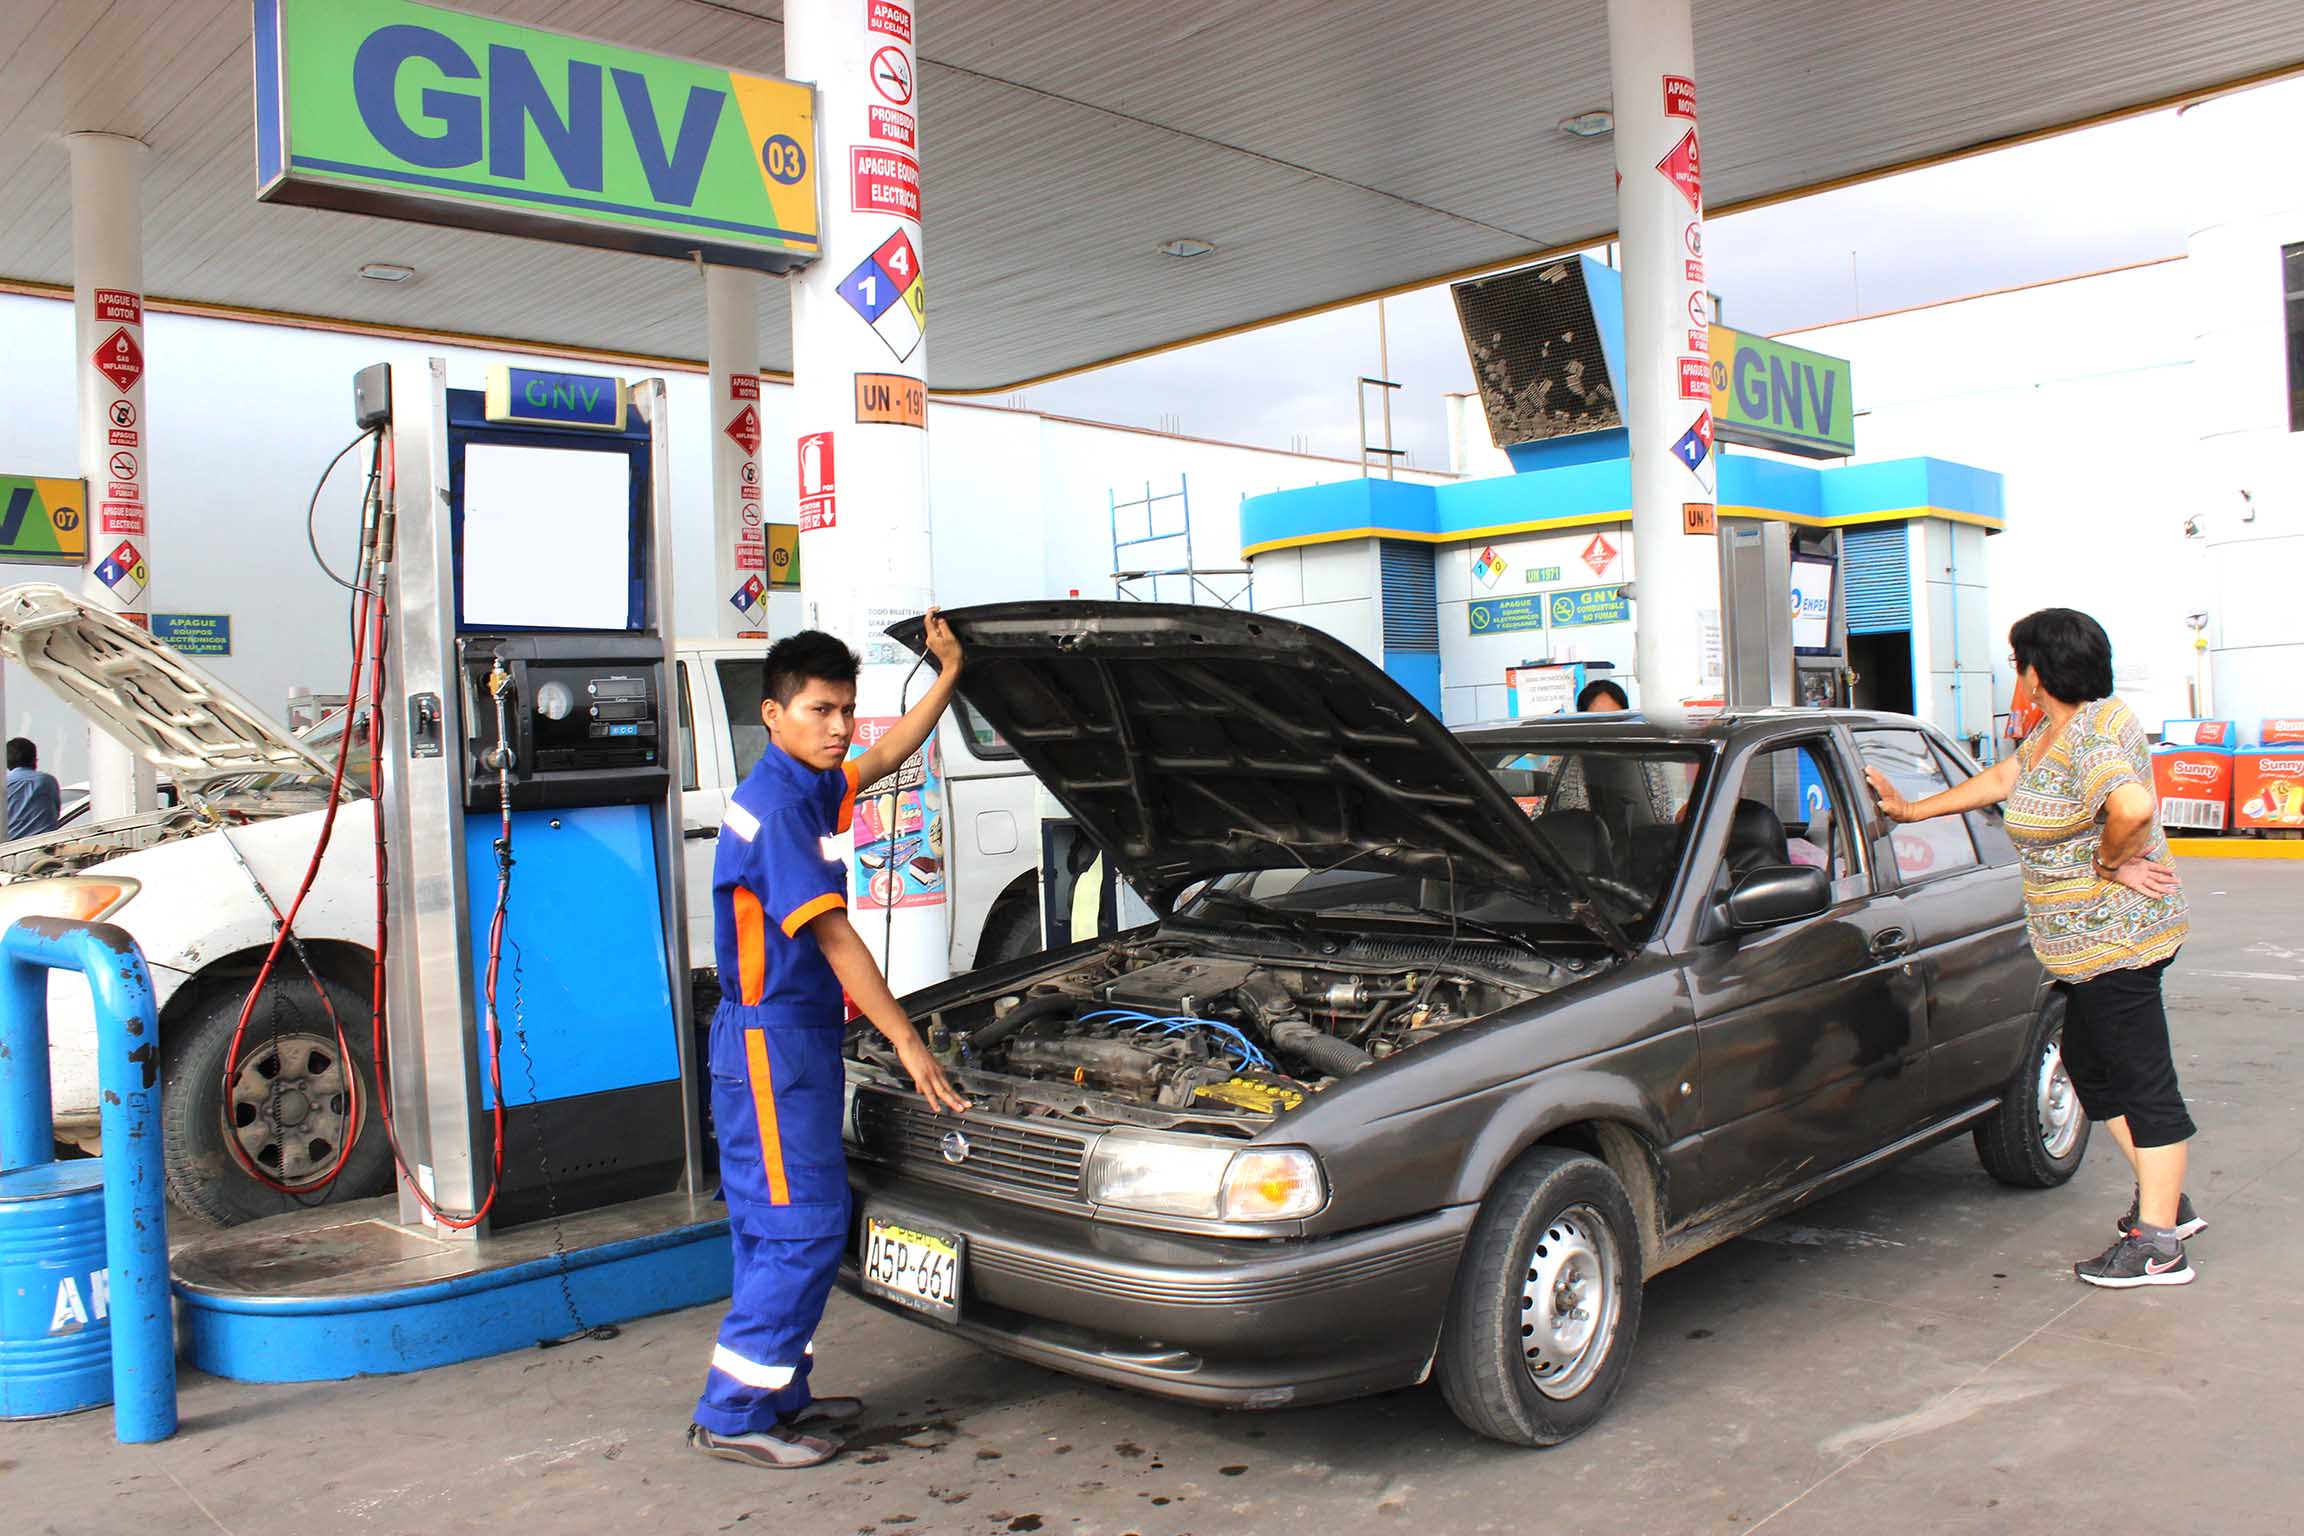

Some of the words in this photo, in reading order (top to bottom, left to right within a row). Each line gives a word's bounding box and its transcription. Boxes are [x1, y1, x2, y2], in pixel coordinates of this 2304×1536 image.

[874, 4, 909, 28] APAGUE
[353, 24, 726, 207] GNV
[872, 107, 914, 131] PROHIBIDO
[882, 123, 910, 142] FUMAR
[768, 141, 800, 178] 03
[858, 157, 897, 178] APAGUE
[872, 183, 917, 212] ELECTRICOS
[888, 246, 909, 275] 4
[98, 294, 131, 306] APAGUE
[858, 276, 876, 306] 1
[915, 286, 924, 313] 0
[107, 307, 135, 319] MOTOR
[1713, 364, 1726, 387] 01
[525, 379, 600, 413] GNV
[864, 385, 890, 411] UN
[1733, 347, 1836, 435] GNV
[1700, 421, 1710, 440] 4
[1684, 440, 1696, 459] 1
[57, 511, 76, 527] 07
[1688, 510, 1704, 526] UN
[119, 549, 132, 563] 4
[775, 552, 787, 563] 05
[103, 565, 114, 580] 1
[136, 566, 145, 579] 0
[1495, 562, 1502, 571] 0
[1581, 590, 1618, 604] GNV
[169, 618, 217, 627] APAGUE
[2174, 760, 2217, 778] Sunny
[869, 1235, 955, 1305] A5P-661
